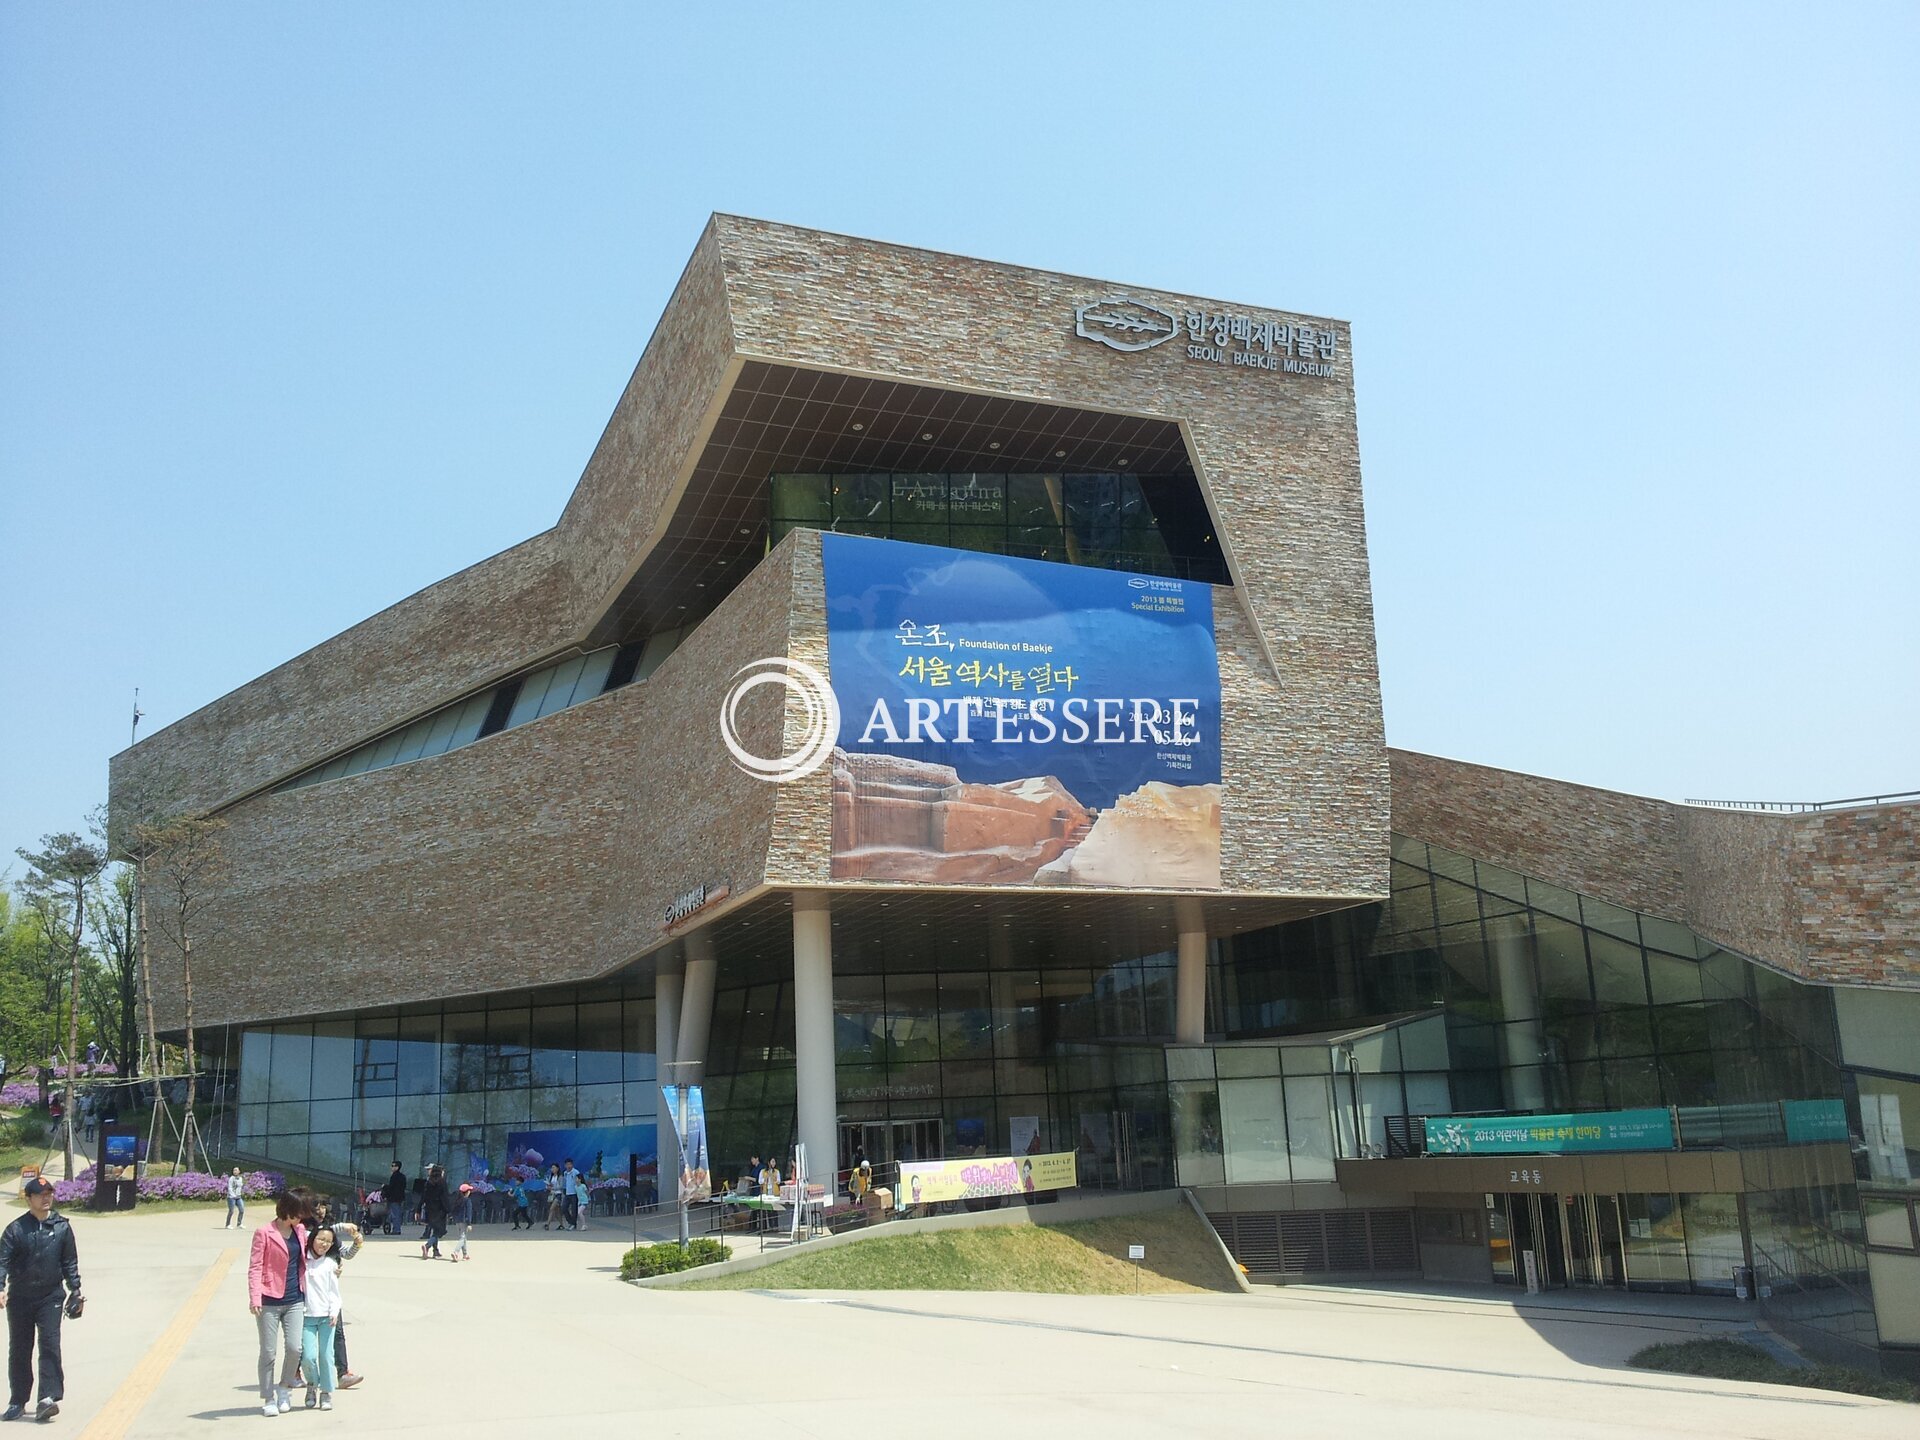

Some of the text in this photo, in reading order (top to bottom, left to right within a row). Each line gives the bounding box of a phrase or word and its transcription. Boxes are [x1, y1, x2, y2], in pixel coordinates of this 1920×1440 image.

[1185, 309, 1336, 360] 한성백제박물관
[1187, 345, 1334, 379] SEOUL BAEKJE MUSEUM
[1131, 601, 1185, 613] Special Exhibition
[1141, 595, 1158, 604] 2013
[959, 638, 1053, 655] Foundation of Baekje
[899, 656, 1080, 694] 서울 역사를 열다
[1474, 1130, 1495, 1142] 2013
[1496, 1128, 1528, 1142] 어린이날
[1510, 1169, 1542, 1184] 교육동
